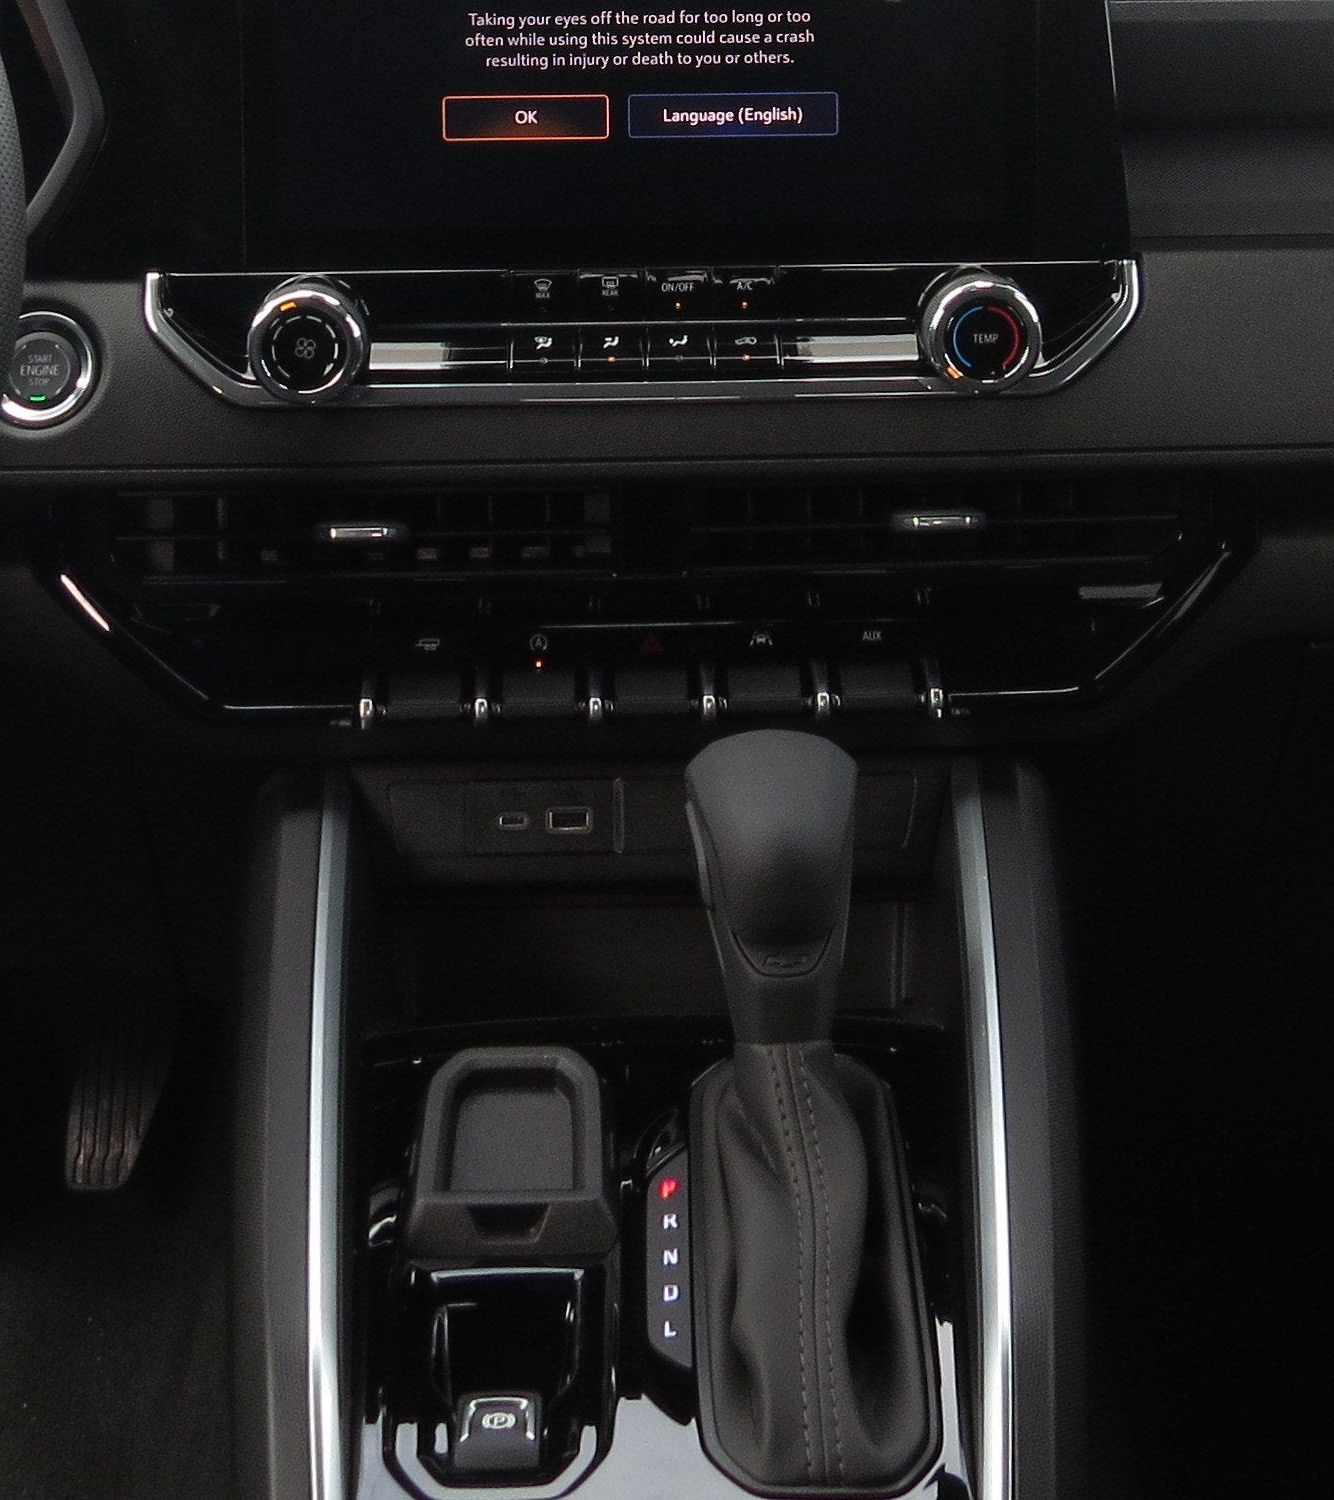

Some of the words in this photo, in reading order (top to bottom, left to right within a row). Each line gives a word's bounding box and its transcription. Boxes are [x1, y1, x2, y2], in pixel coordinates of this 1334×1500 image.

[468, 12, 515, 30] Taking
[518, 15, 552, 30] your
[554, 15, 588, 29] eyes
[591, 10, 613, 25] off
[615, 10, 639, 25] the
[643, 10, 676, 25] road
[679, 9, 701, 24] for
[703, 11, 729, 24] too
[731, 9, 764, 27] long
[767, 12, 784, 23] or
[787, 10, 811, 23] too
[465, 32, 504, 47] often
[507, 31, 546, 46] while
[549, 32, 588, 50] using
[591, 31, 619, 46] this
[621, 32, 673, 49] system
[676, 29, 716, 45] could
[719, 33, 761, 44] cause
[763, 33, 773, 44] a
[776, 28, 815, 43] crash
[485, 52, 549, 70] resulting
[552, 53, 566, 66] in
[569, 52, 610, 70] injury
[613, 54, 629, 65] or
[631, 51, 674, 66] death
[676, 52, 692, 65] to
[695, 54, 721, 69] you
[724, 54, 741, 65] or
[743, 49, 795, 64] others.
[514, 110, 538, 125] OK
[663, 108, 735, 129] Language
[738, 106, 803, 127] (English)
[601, 289, 619, 297] REAR
[661, 282, 694, 293] ON/OFF
[736, 281, 754, 291] A/C
[535, 292, 551, 300] MAX
[972, 333, 999, 345] TEMP
[27, 354, 53, 364] START
[20, 364, 60, 376] ENGINE
[28, 378, 50, 388] STOP
[862, 631, 882, 642] AUX
[662, 1179, 677, 1199] P
[662, 1213, 678, 1230] R
[662, 1248, 679, 1265] N
[662, 1284, 679, 1302] D
[663, 1320, 677, 1338] L
